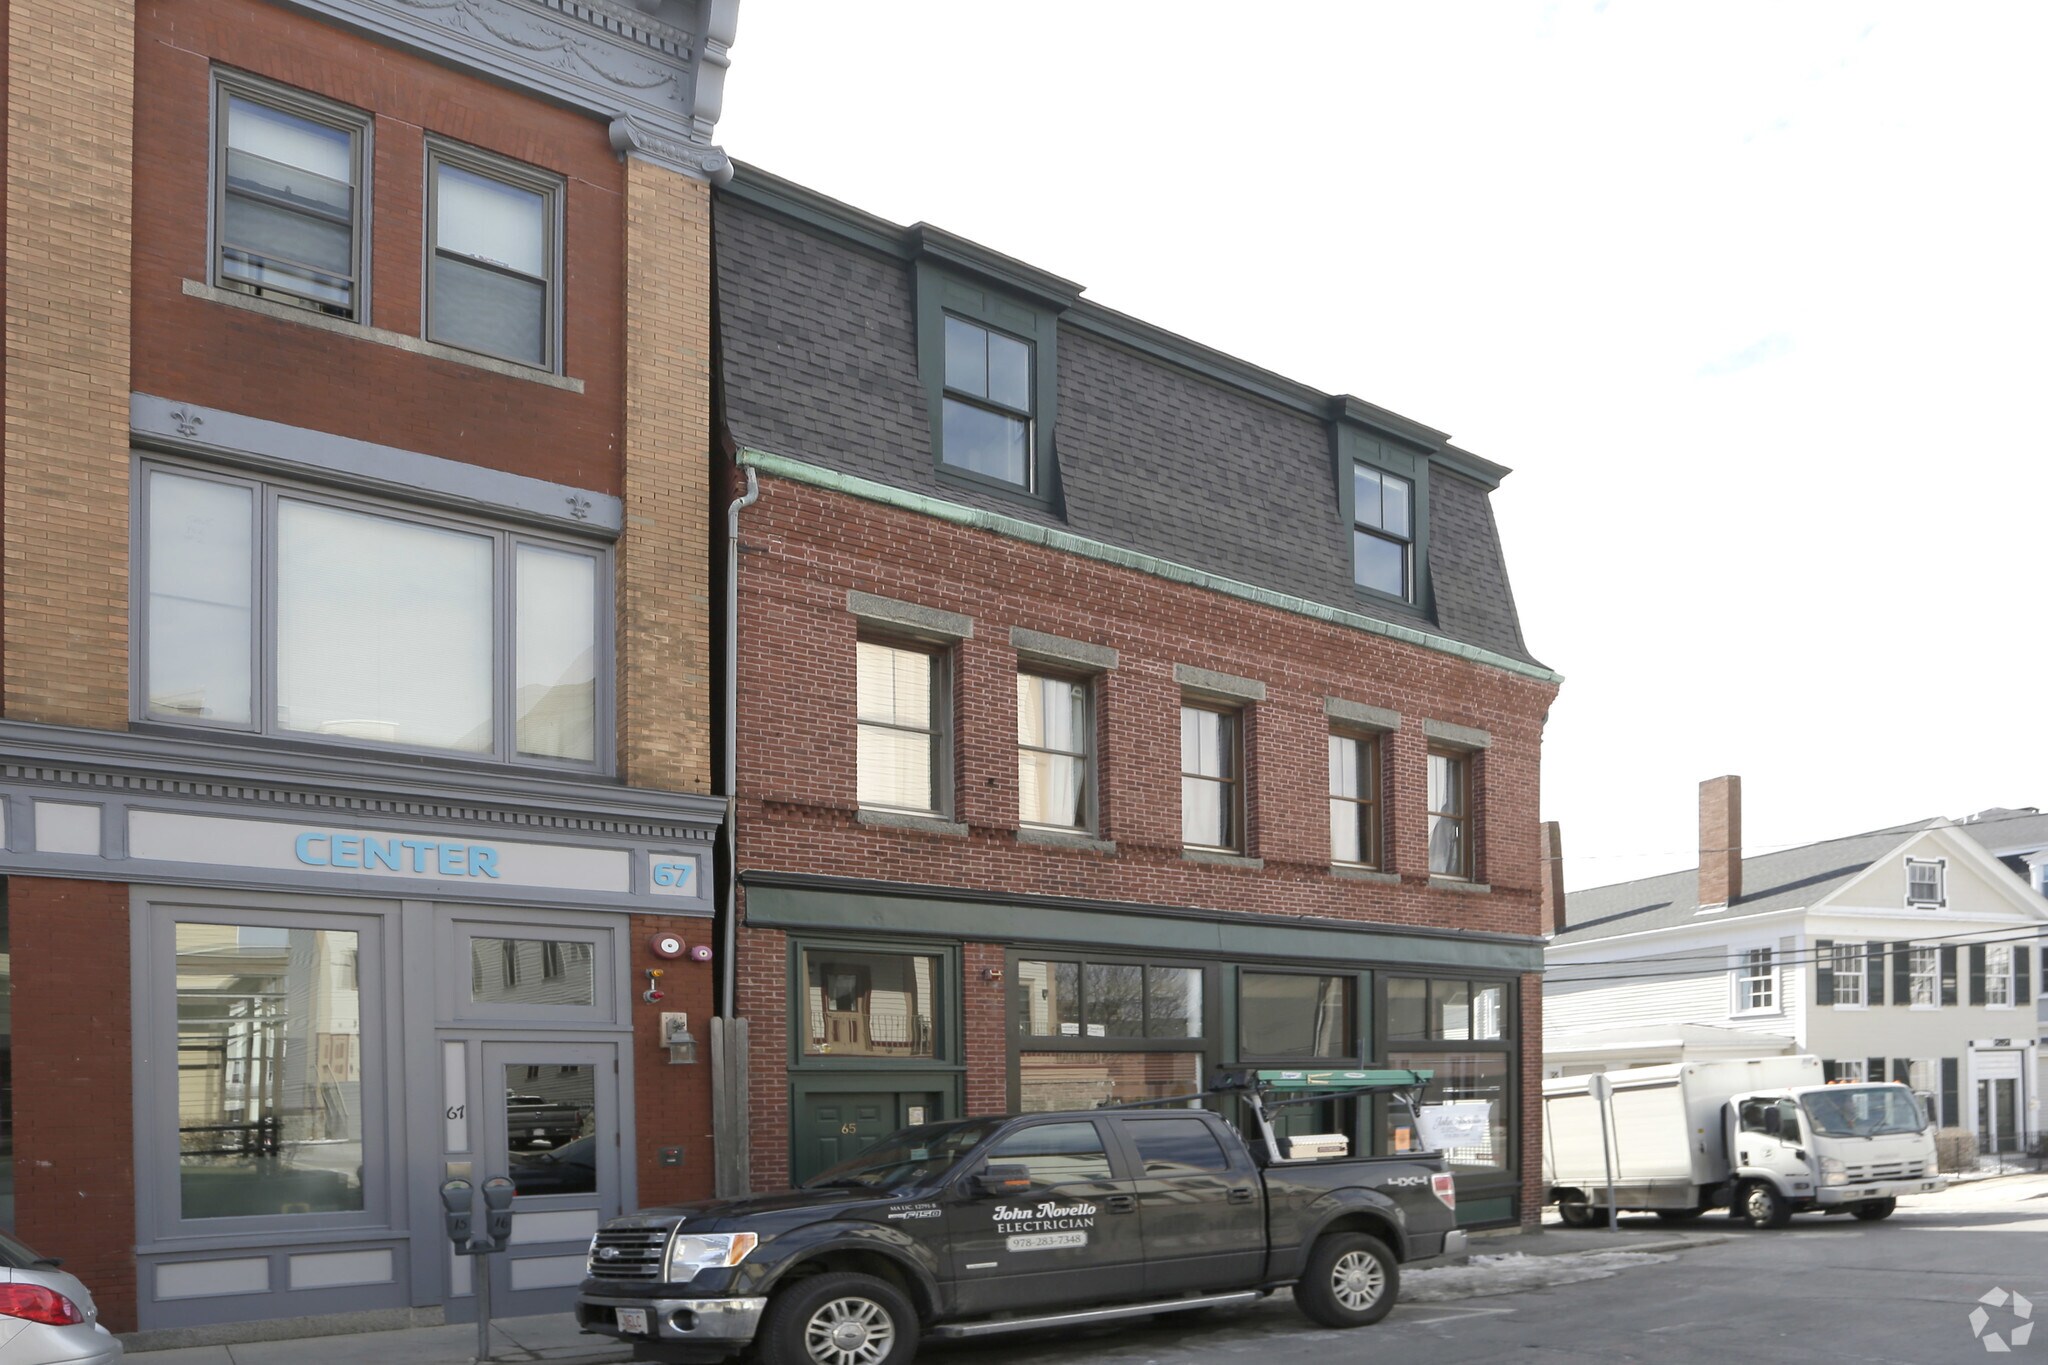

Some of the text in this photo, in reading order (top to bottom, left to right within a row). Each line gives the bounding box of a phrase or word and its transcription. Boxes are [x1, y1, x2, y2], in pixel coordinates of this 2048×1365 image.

[295, 832, 500, 878] CENTER
[653, 863, 693, 888] 67
[447, 1105, 465, 1120] 67
[841, 1123, 857, 1134] 65
[992, 1201, 1097, 1221] John Novello
[454, 1219, 467, 1230] 15
[997, 1217, 1095, 1233] ELECTRICIAN
[1012, 1234, 1082, 1248] 978-283-7348
